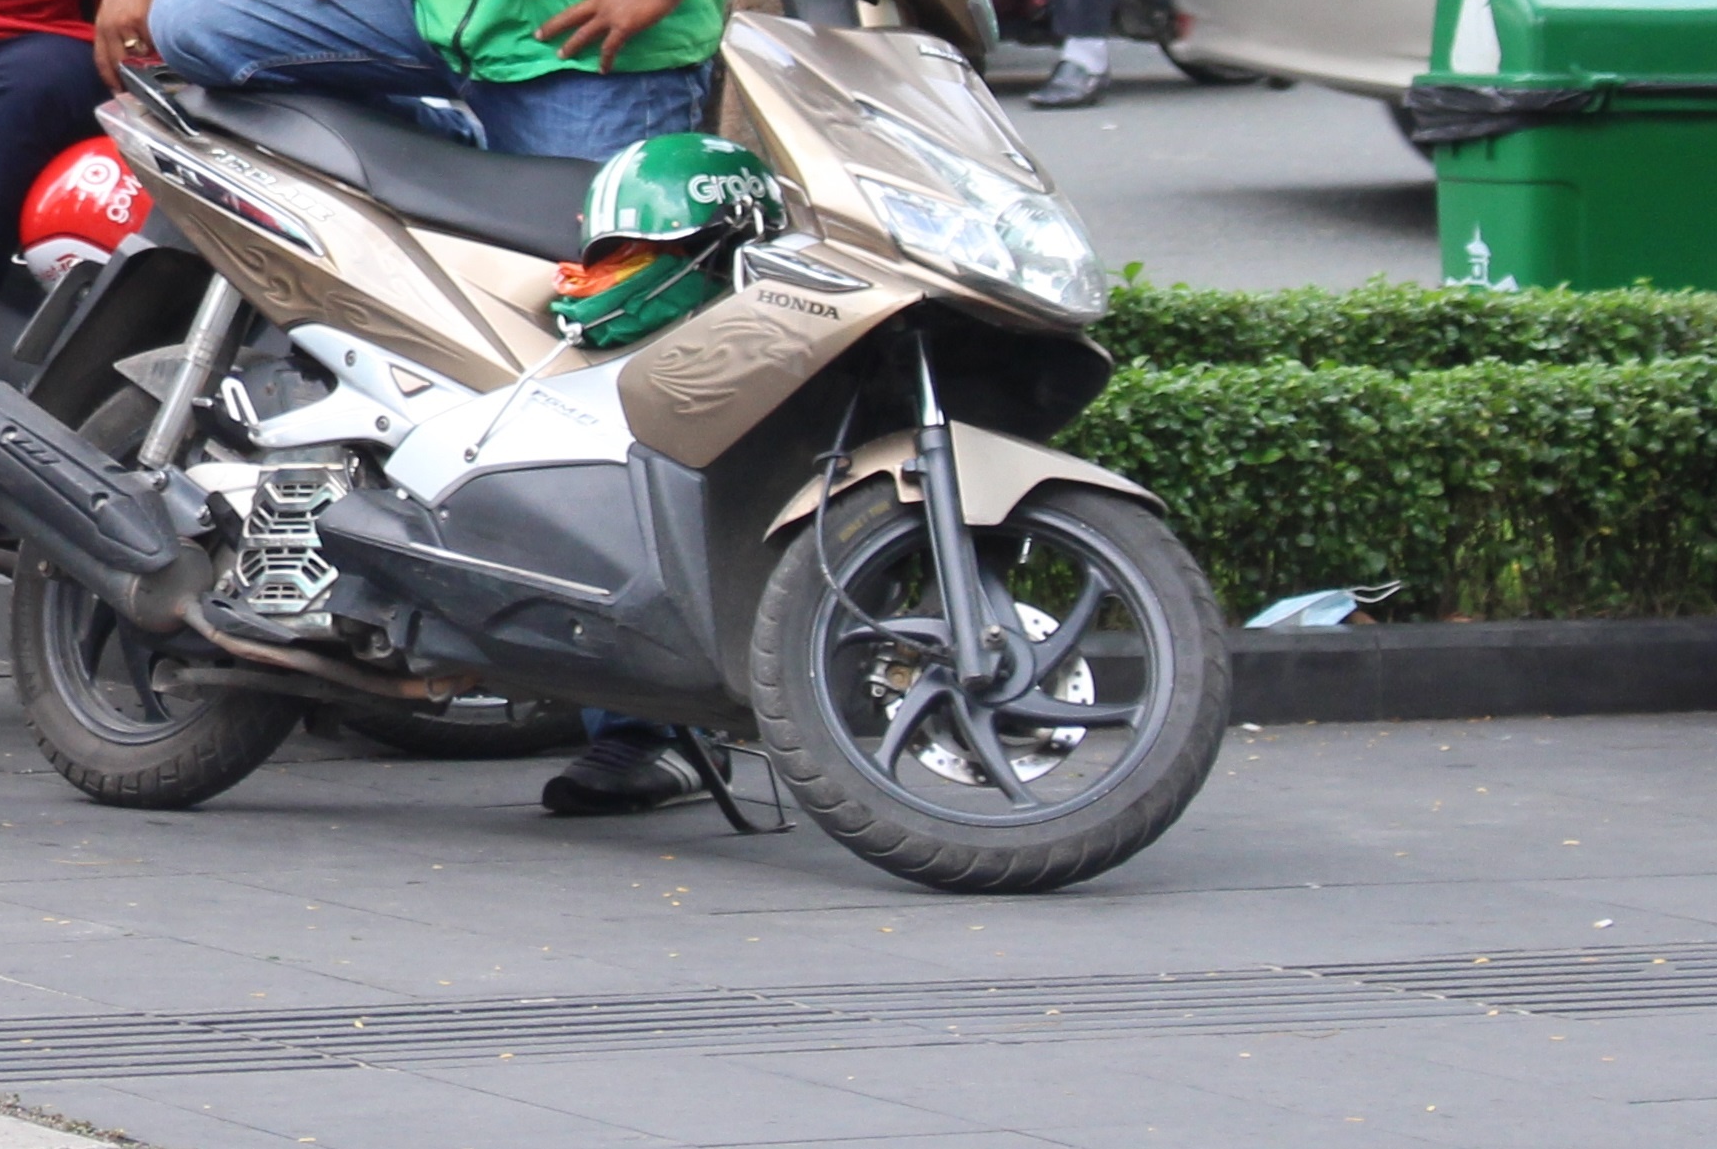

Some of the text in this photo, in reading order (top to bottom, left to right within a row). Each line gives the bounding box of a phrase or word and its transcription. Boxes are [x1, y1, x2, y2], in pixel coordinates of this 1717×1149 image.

[106, 174, 143, 223] govi
[688, 167, 766, 203] Grab
[756, 289, 842, 320] HONDA
